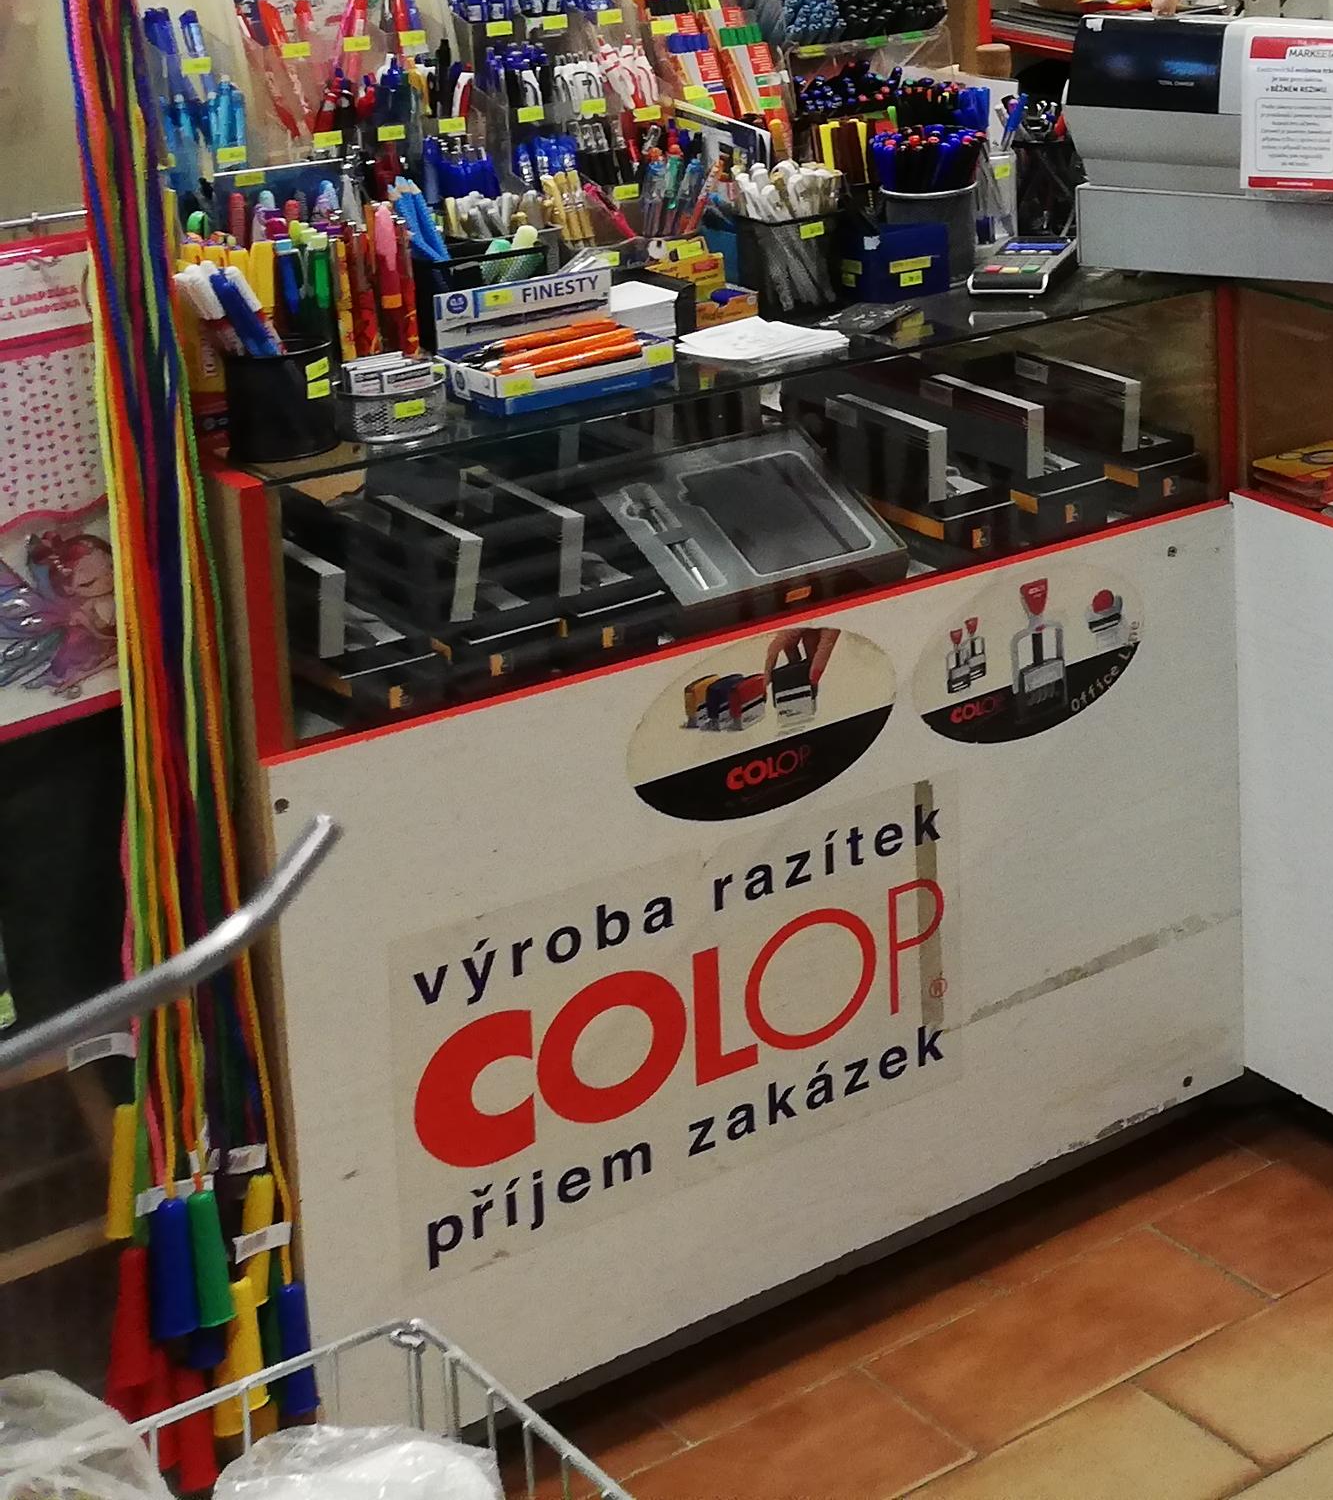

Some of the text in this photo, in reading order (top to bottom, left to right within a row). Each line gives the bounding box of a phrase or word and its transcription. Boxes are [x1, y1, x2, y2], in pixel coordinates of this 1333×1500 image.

[522, 274, 600, 304] FINESTY
[1069, 618, 1143, 713] Office Line
[725, 744, 812, 791] COLOP
[413, 802, 942, 1008] výroba razítek
[414, 878, 946, 1168] COLOP
[425, 1025, 947, 1268] příjem zakázek
